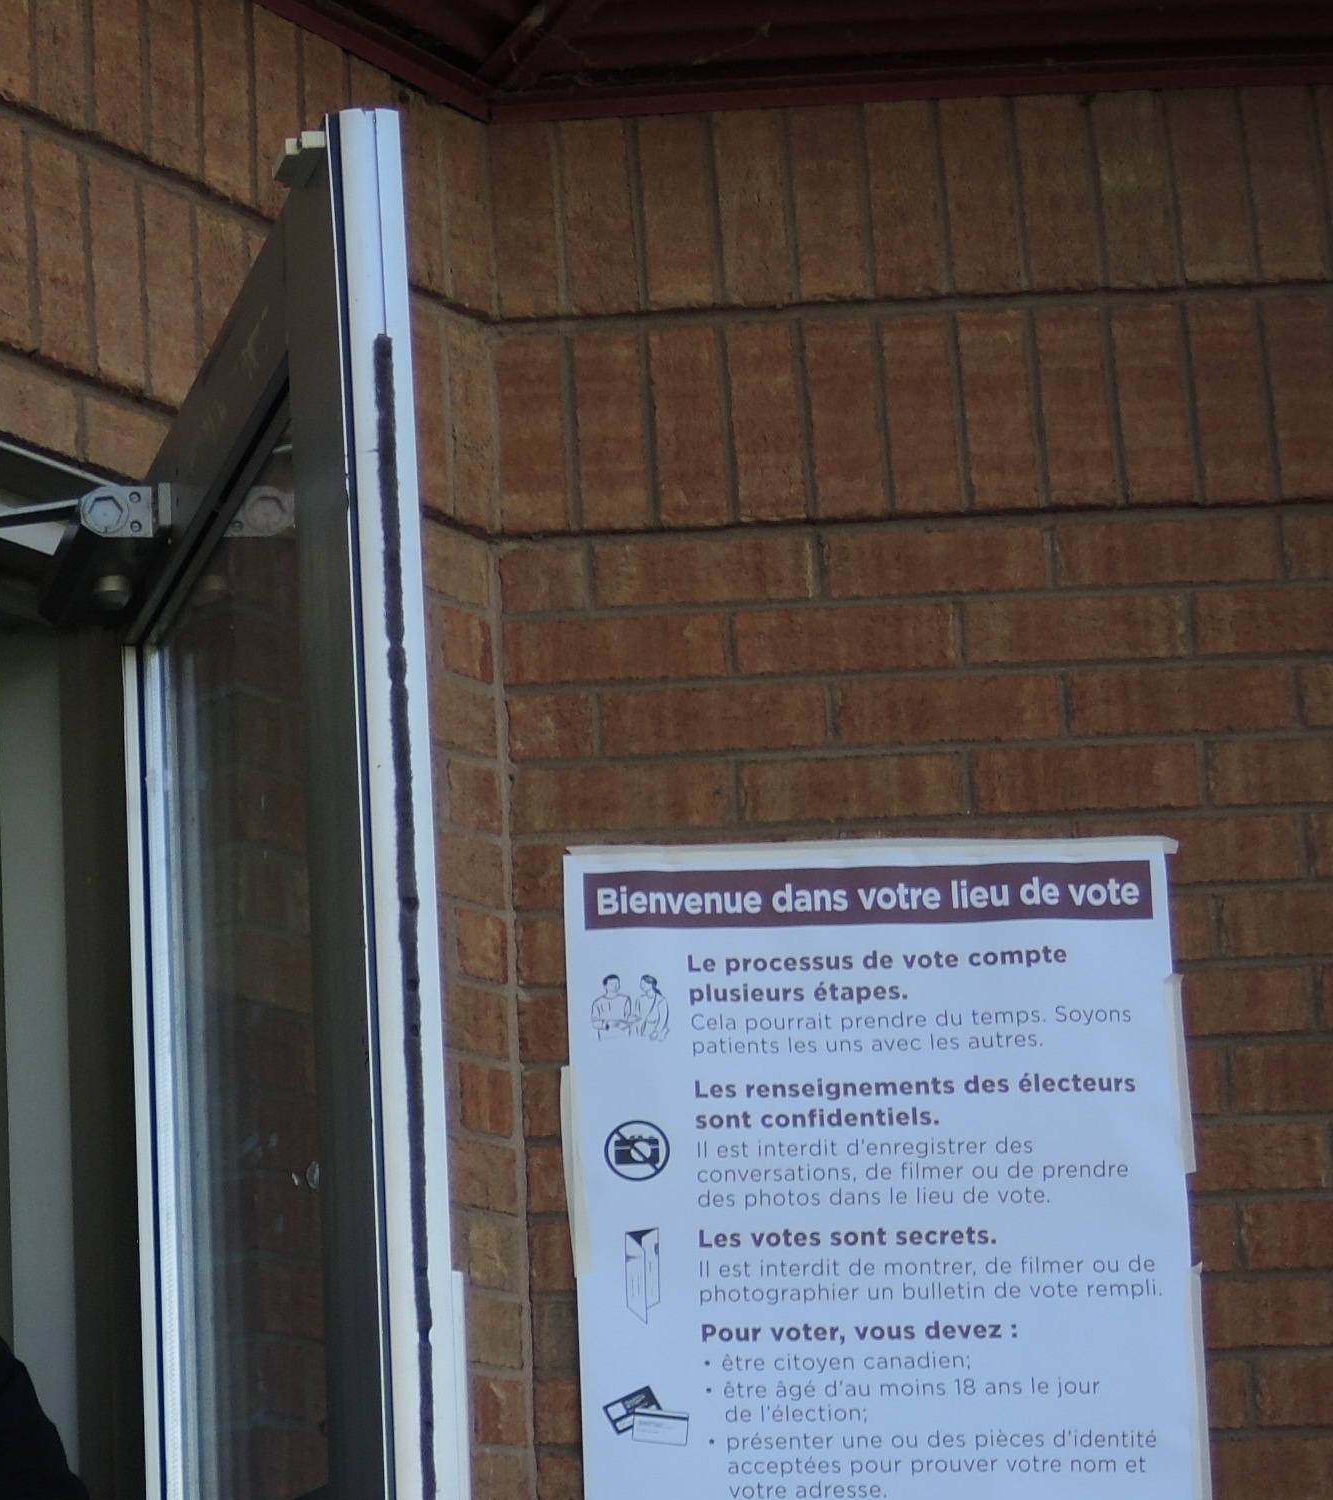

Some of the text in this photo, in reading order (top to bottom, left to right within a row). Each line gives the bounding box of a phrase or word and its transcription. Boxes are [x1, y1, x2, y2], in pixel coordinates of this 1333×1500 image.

[596, 876, 1140, 916] Bienvenue dans votre lieu de vote
[686, 945, 1067, 976] Le processus de vote compte
[688, 980, 908, 1006] plusieurs étapes.
[690, 1004, 1131, 1035] Cela pourrait prendre du temps. Soyons
[694, 1071, 1136, 1101] Les renseignements des électeurs
[695, 1105, 940, 1130] sont confidentiels.
[698, 1225, 997, 1248] Les votes sont secrets.
[699, 1277, 1162, 1307] photographier un bulletin de vote rempli.
[700, 1323, 762, 1342] Pour
[769, 1322, 845, 1345] voter,
[853, 1324, 916, 1341] vous
[924, 1319, 1002, 1340] devez
[721, 1350, 971, 1374] être citoyen canadien;
[724, 1403, 867, 1424] de l'élection;
[728, 1479, 887, 1500] votre adresse.
